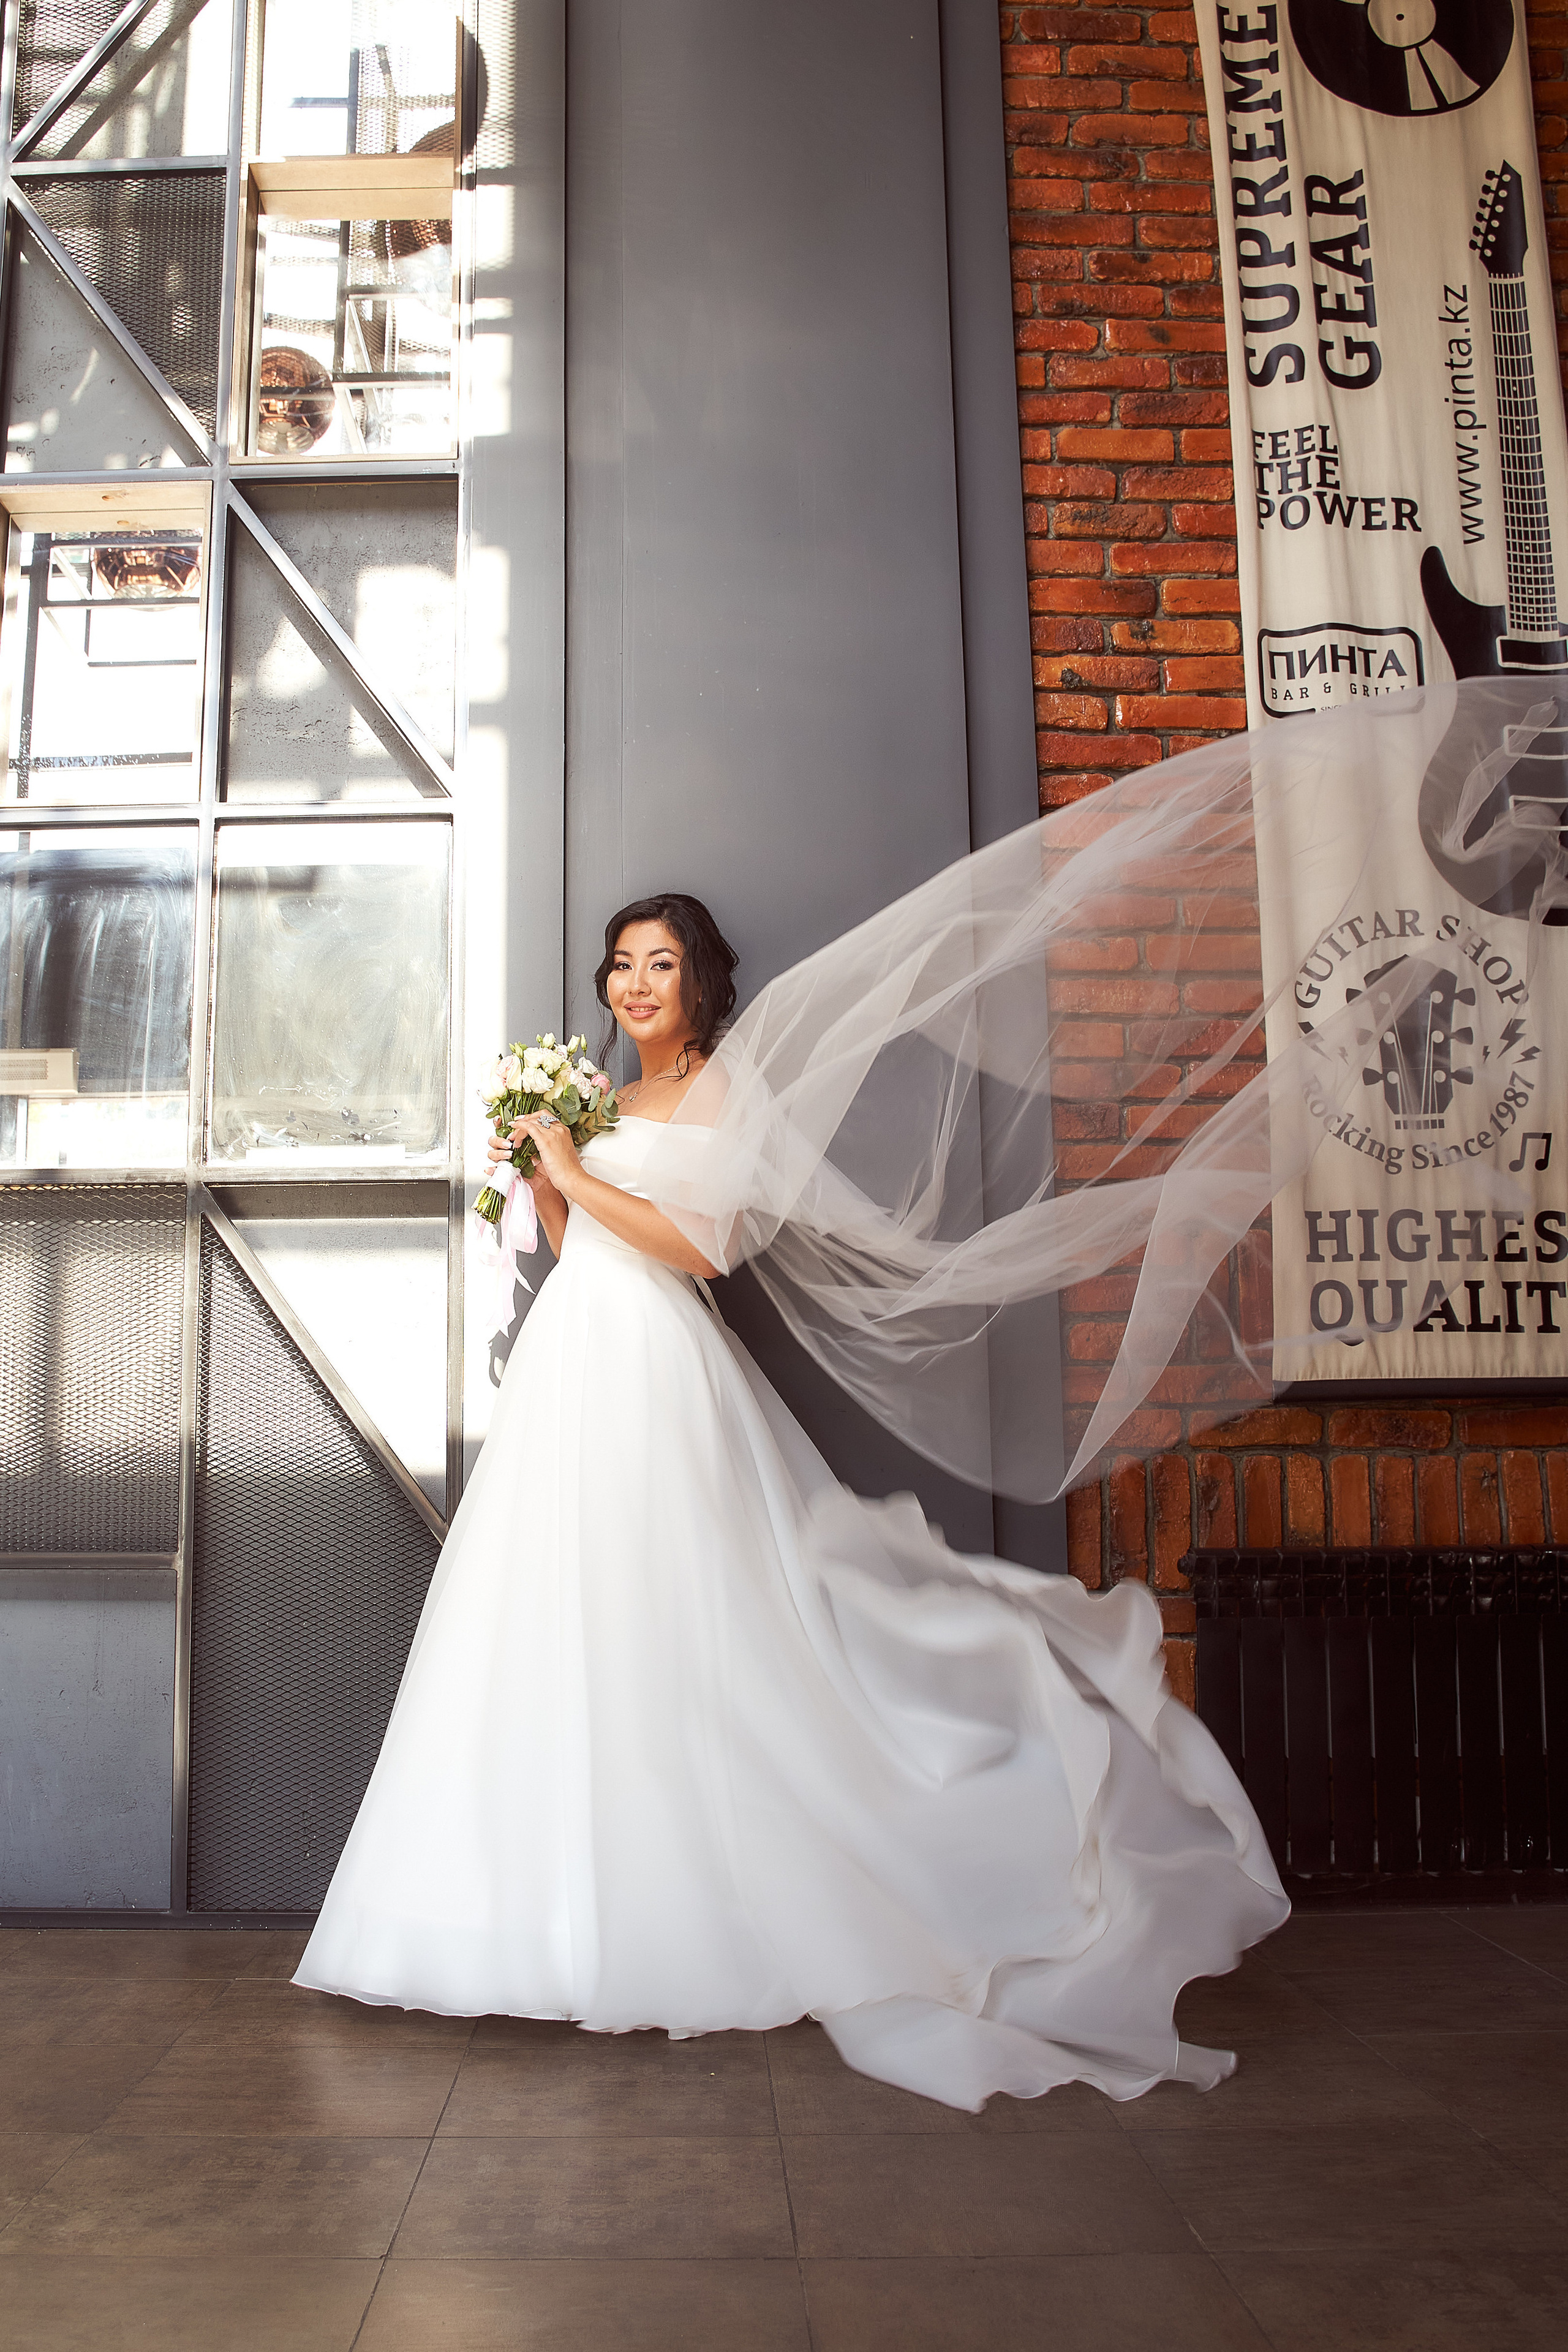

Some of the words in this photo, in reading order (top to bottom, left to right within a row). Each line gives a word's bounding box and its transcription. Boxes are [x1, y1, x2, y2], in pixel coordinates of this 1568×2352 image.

[1216, 4, 1305, 389] SUPREME
[1304, 169, 1382, 390] GEAR
[1251, 424, 1338, 460] FEEL
[1438, 284, 1487, 545] www.pinta.kz
[1254, 454, 1341, 496] THE
[1256, 491, 1422, 532] POWER
[1268, 644, 1408, 680] ПИНТА
[1270, 687, 1310, 701] BAR
[1323, 682, 1332, 693] &
[1294, 909, 1425, 1009] GUITAR
[1435, 914, 1529, 1006] SHOP
[1302, 1074, 1405, 1175] Rocking
[1412, 1130, 1495, 1170] Since
[1489, 1071, 1535, 1137] 1987
